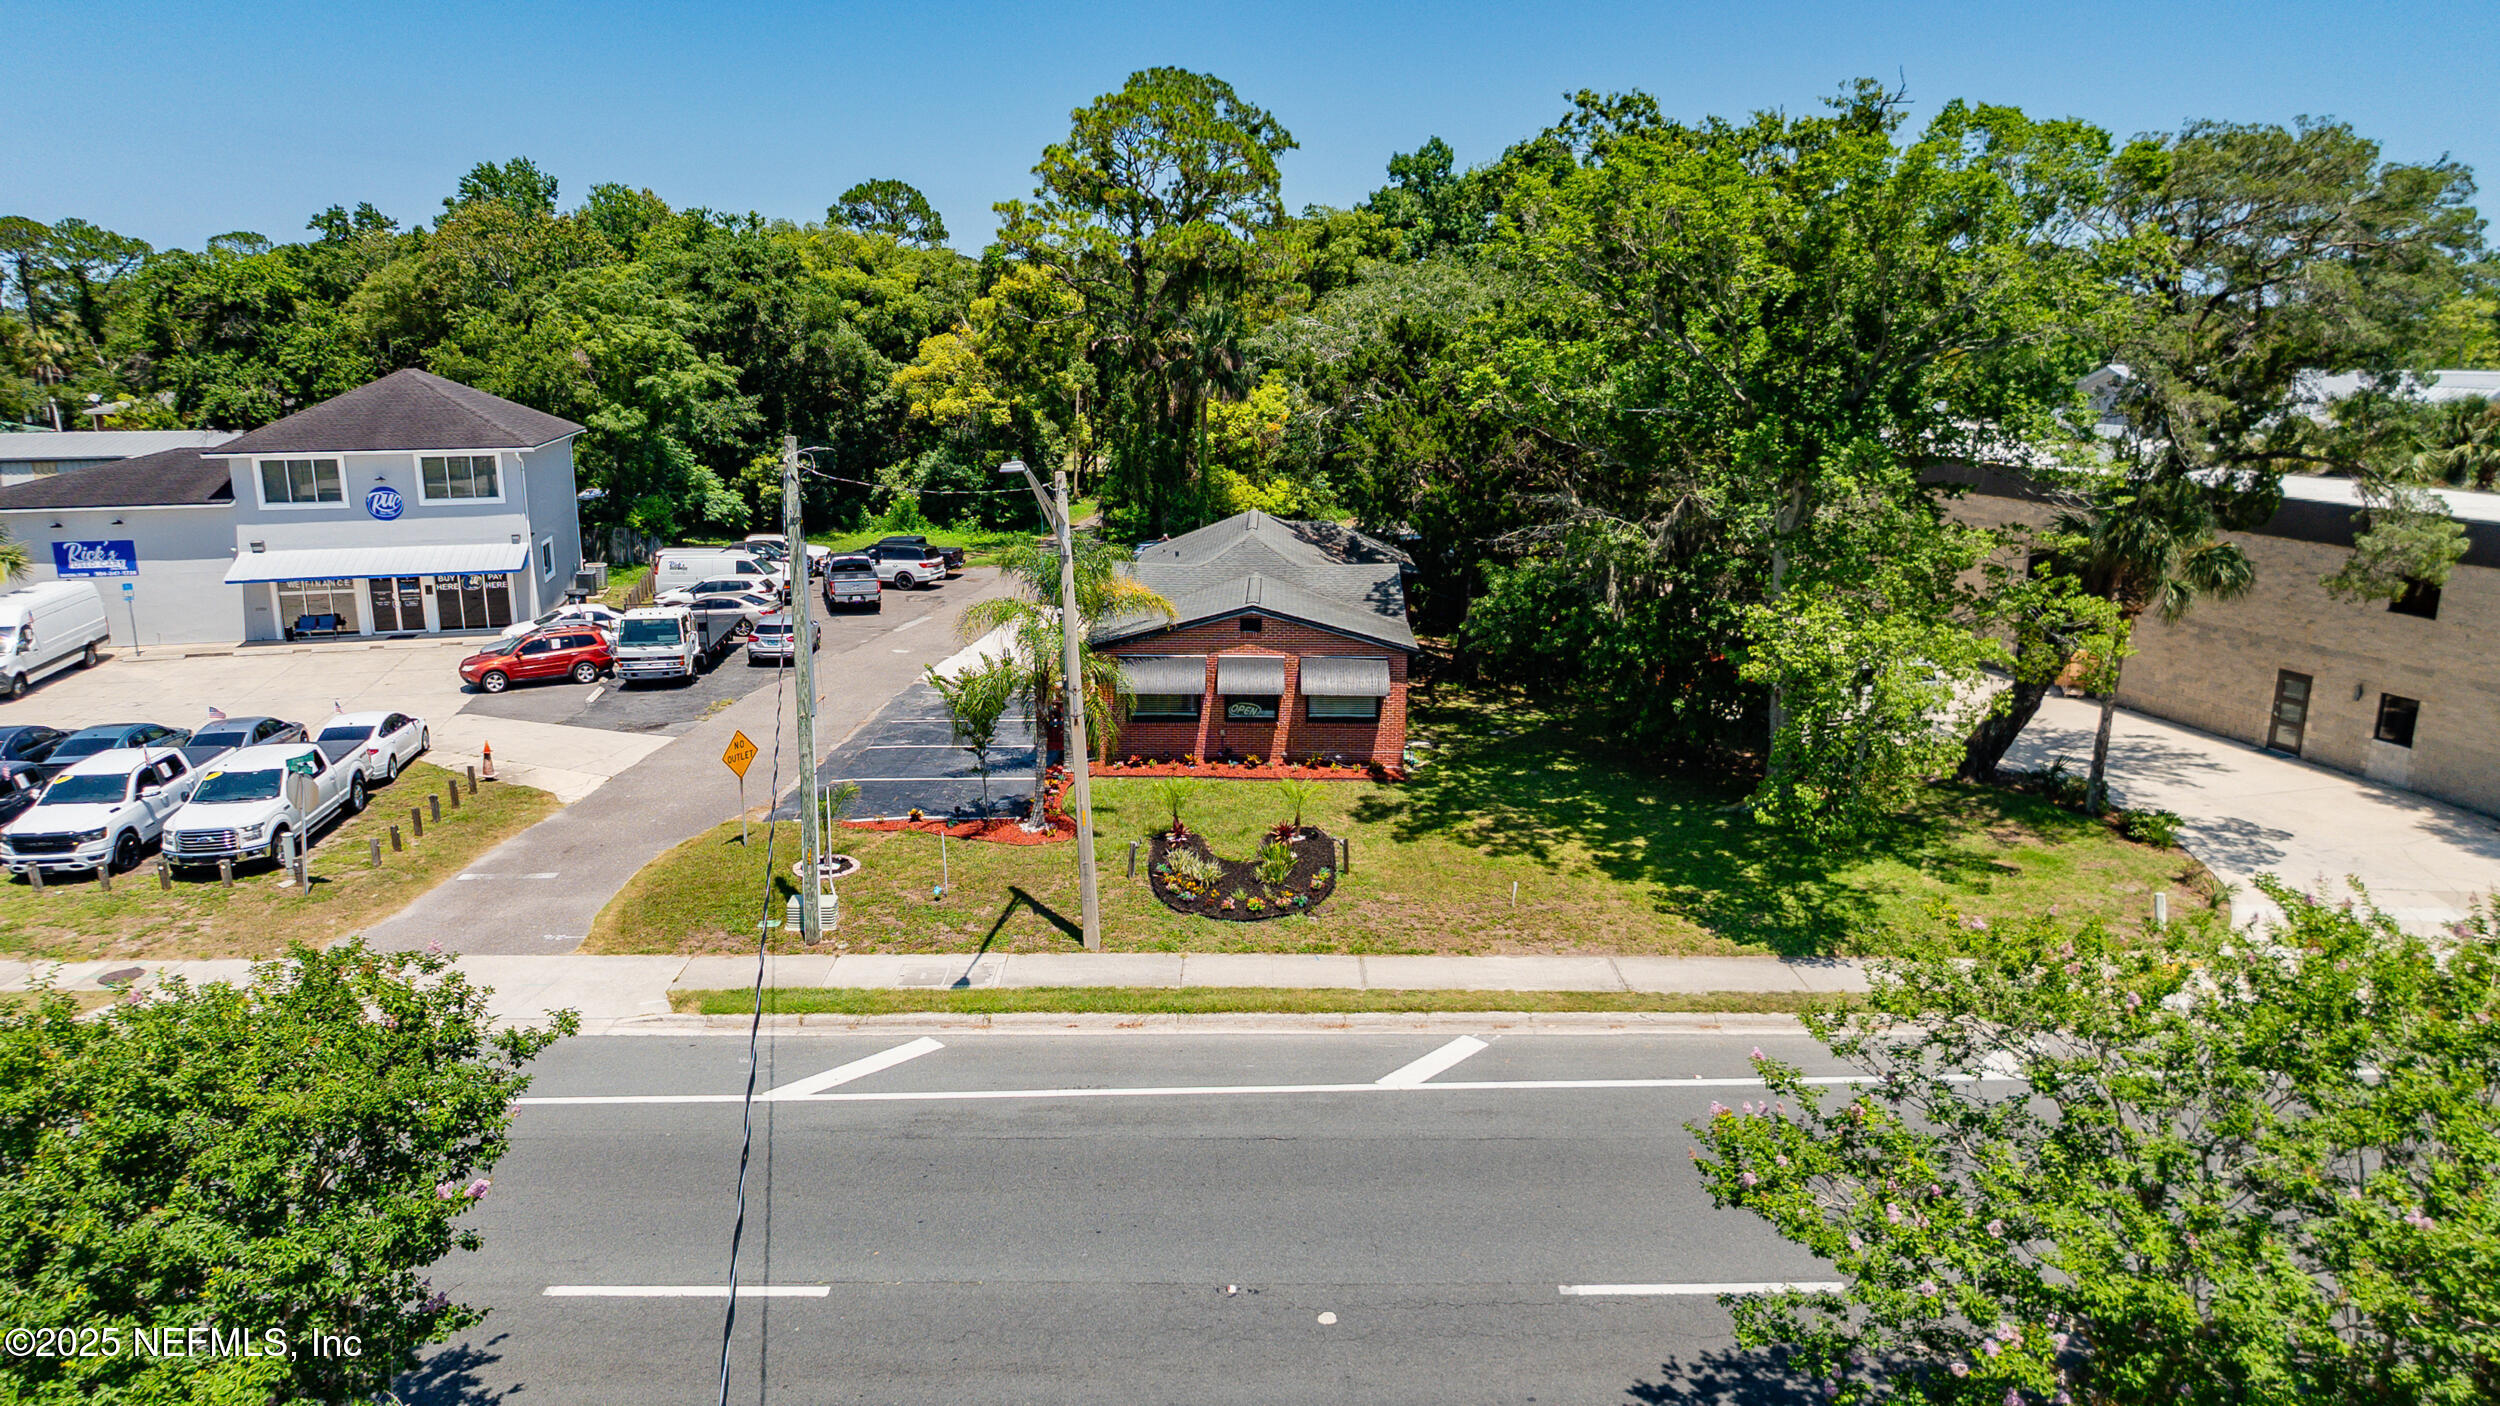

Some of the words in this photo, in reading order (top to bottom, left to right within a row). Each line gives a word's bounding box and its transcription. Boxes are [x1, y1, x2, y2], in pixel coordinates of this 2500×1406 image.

[63, 540, 118, 562] Rick's
[304, 579, 352, 587] FINANCE
[486, 581, 509, 589] HERE
[1231, 704, 1258, 716] OPEN
[734, 740, 744, 749] NO
[728, 750, 753, 764] OUTLET
